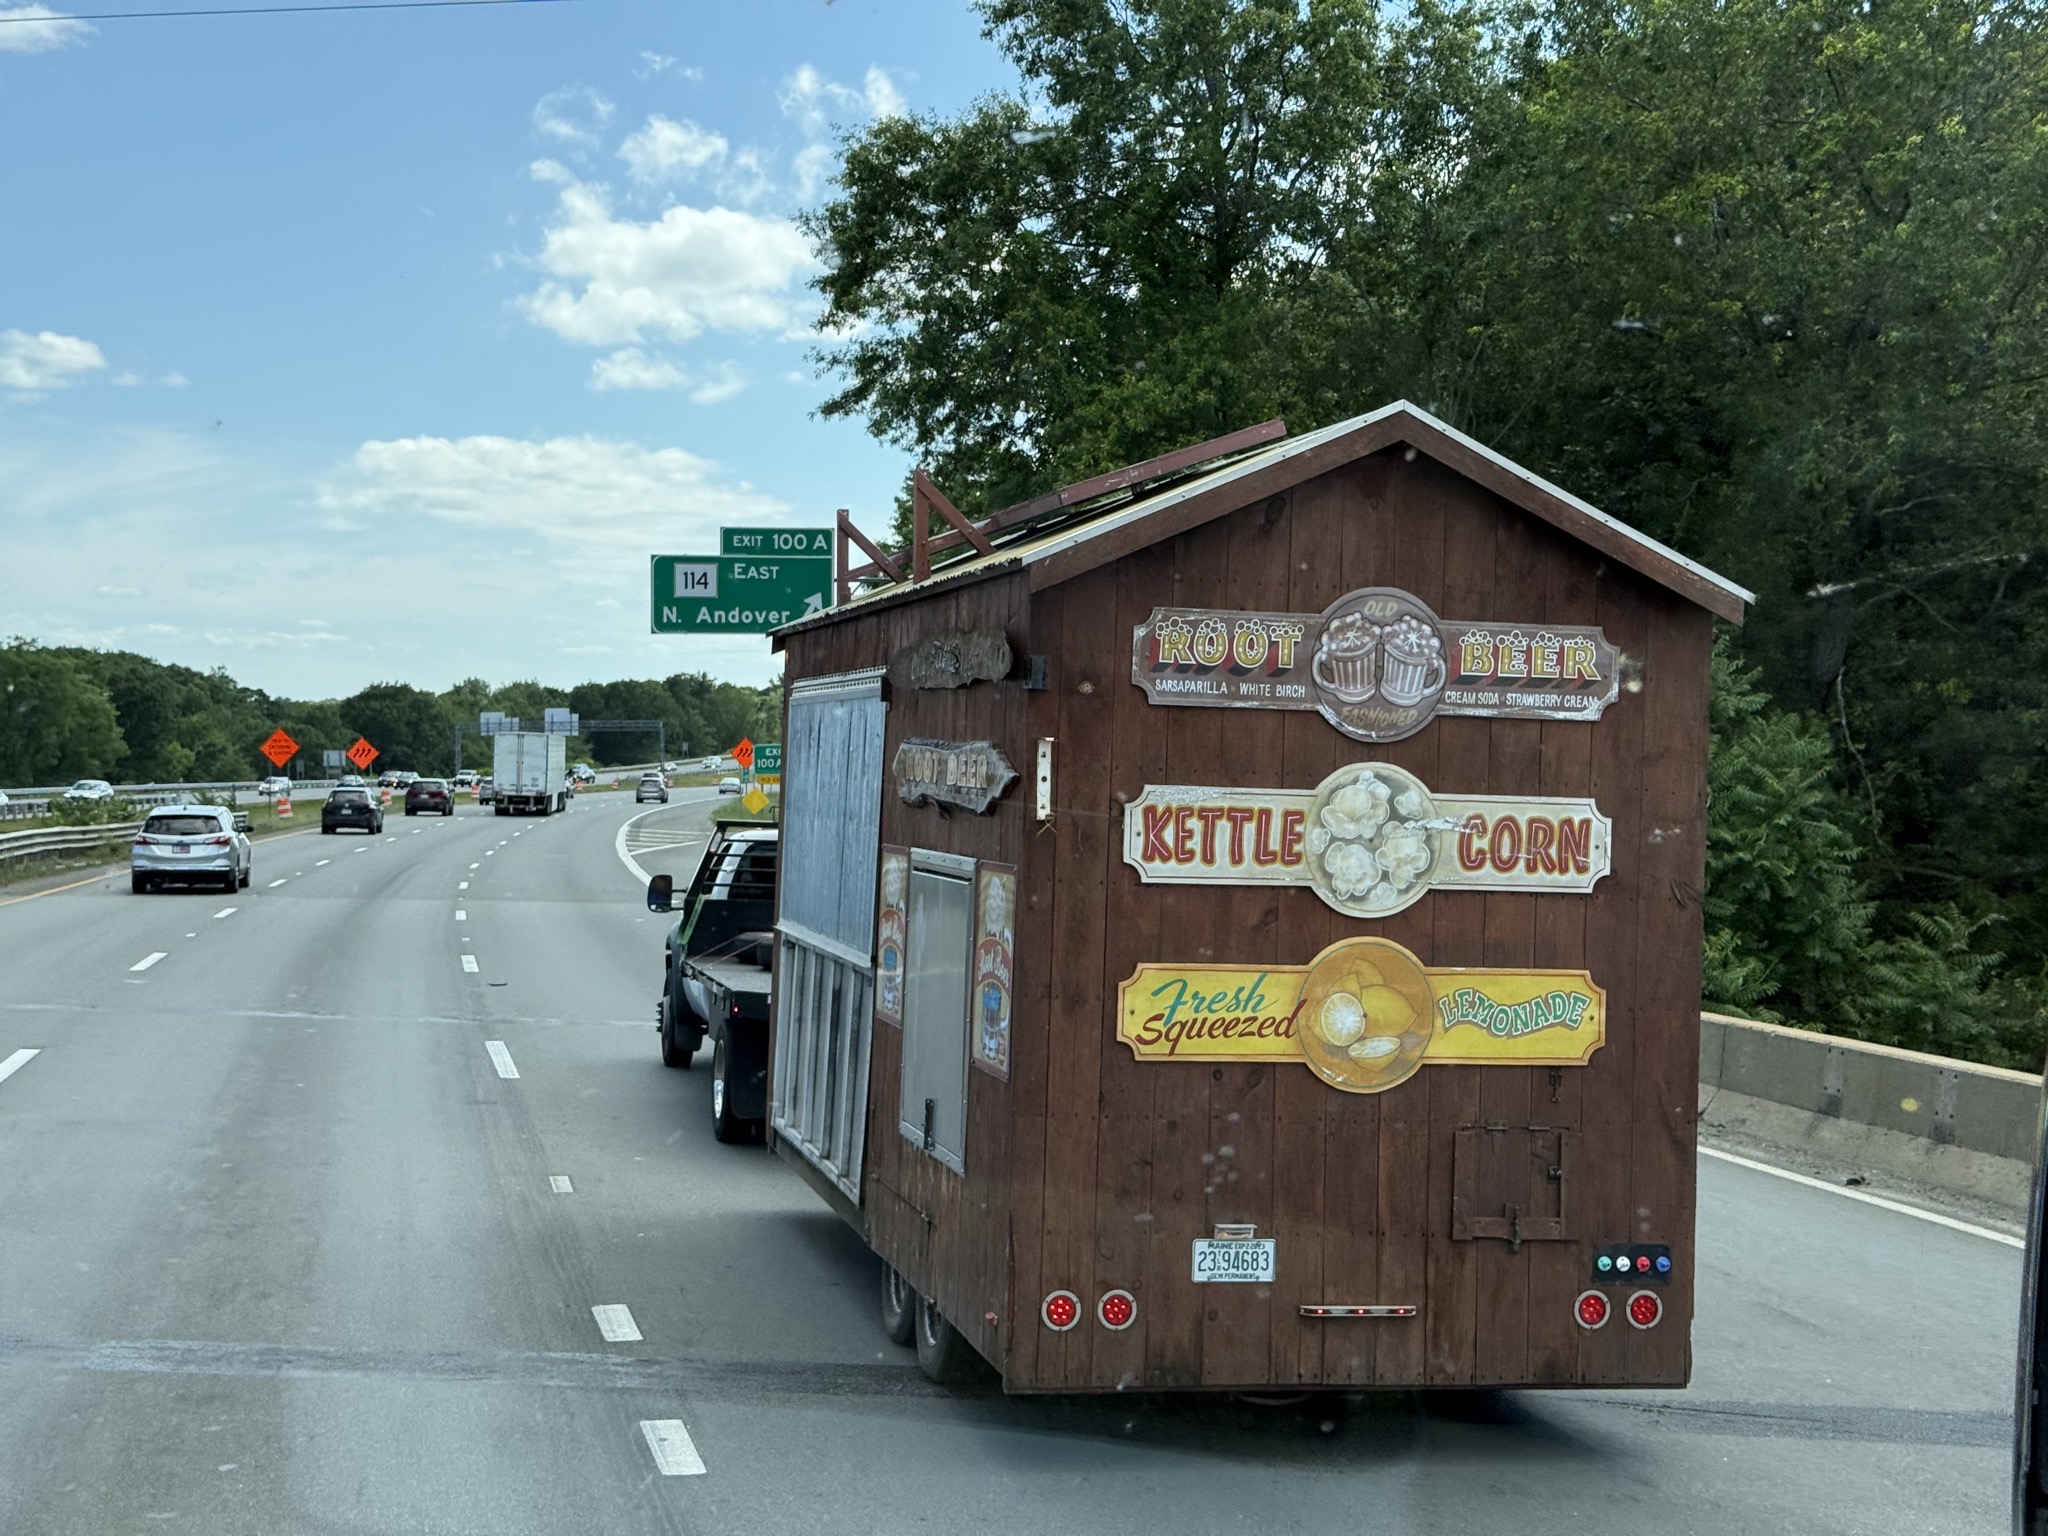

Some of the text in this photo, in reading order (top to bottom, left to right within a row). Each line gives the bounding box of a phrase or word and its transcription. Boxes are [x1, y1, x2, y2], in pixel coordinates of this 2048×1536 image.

[733, 534, 828, 550] EXIT 100 A
[682, 571, 709, 589] 114
[734, 563, 780, 579] EAST
[662, 606, 791, 624] N. Andover
[1364, 600, 1398, 617] OLD
[1152, 617, 1602, 685] ROOT BEER
[1155, 679, 1305, 698] SARSAPARILLA WHITE BIRCH
[1445, 691, 1598, 708] CREAM SODA STRAWBERRY CREAM
[1341, 706, 1418, 727] FASHIONED
[766, 748, 781, 756] EXI
[757, 759, 775, 768] 100
[905, 751, 987, 788] ROOT BEER
[1142, 803, 1593, 876] KETTLE CORN
[1151, 972, 1279, 1027] Fresh
[1438, 987, 1592, 1037] LEMONADE
[1135, 999, 1308, 1056] Squeezed
[1207, 1242, 1233, 1250] MAINE
